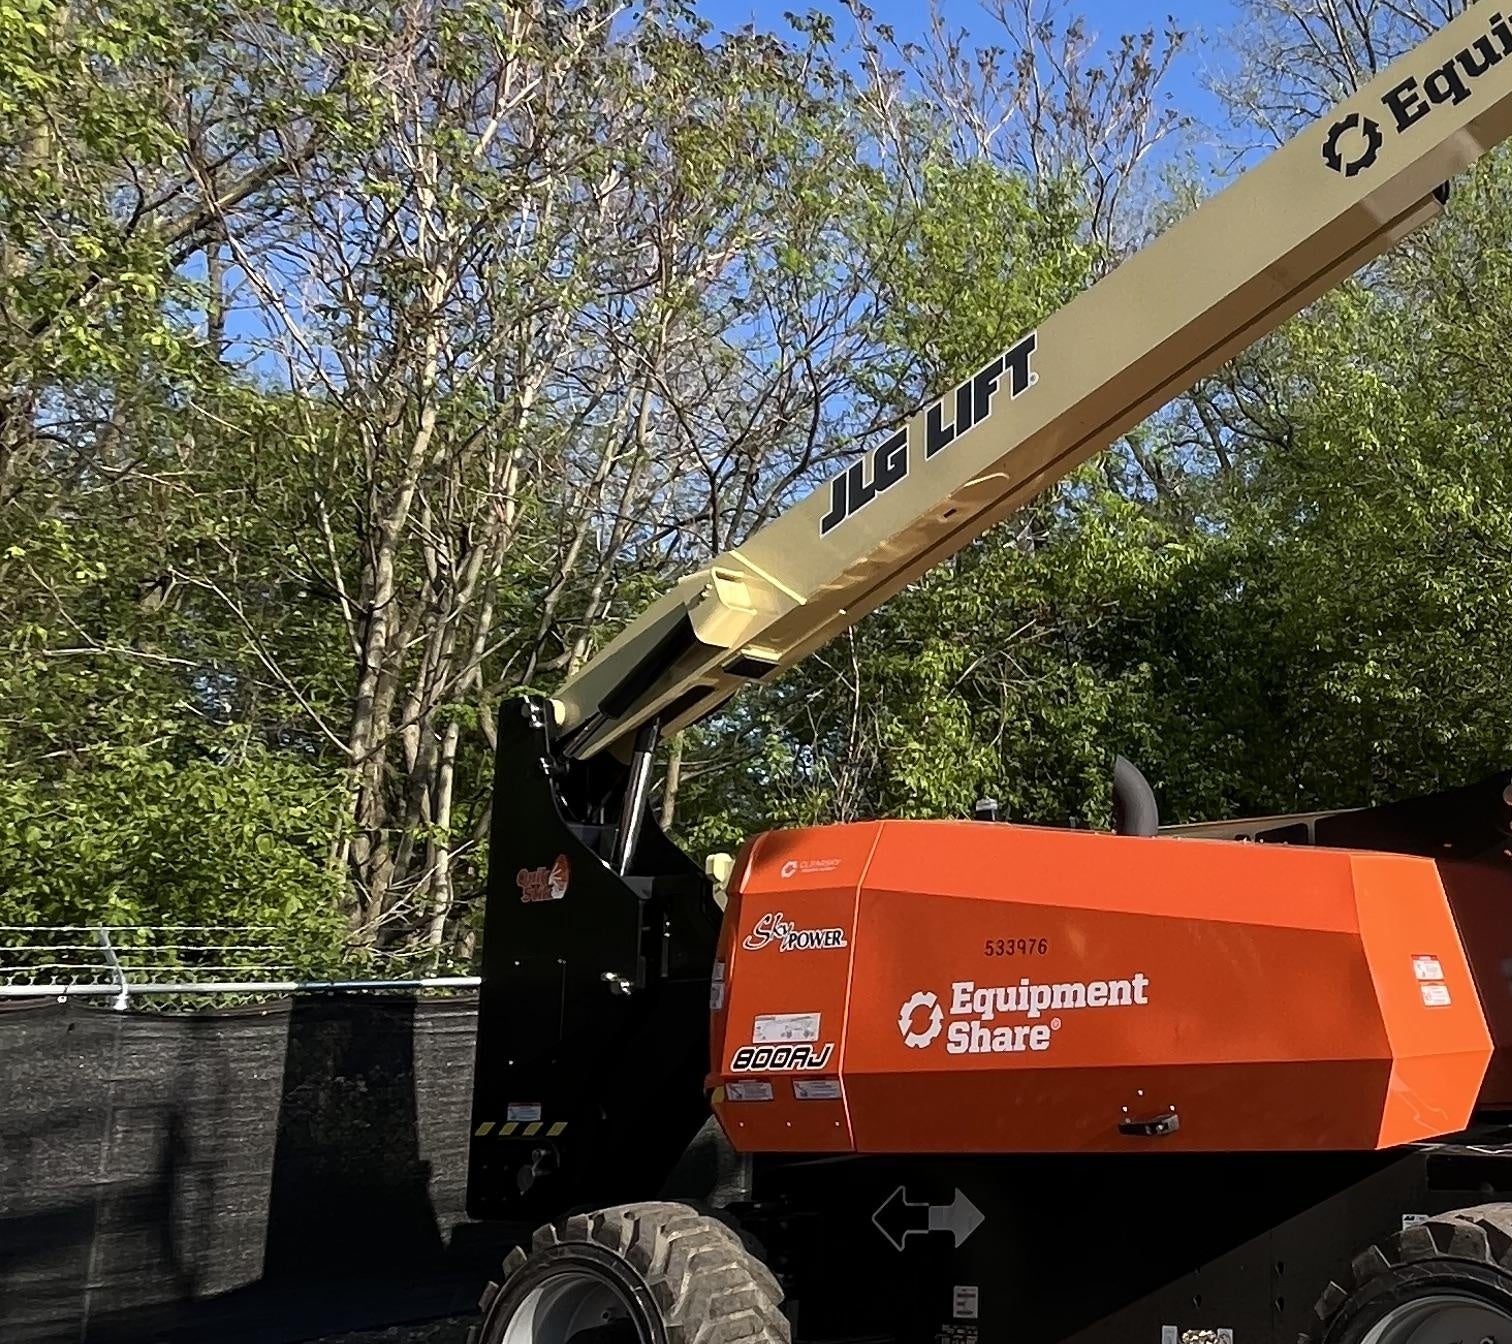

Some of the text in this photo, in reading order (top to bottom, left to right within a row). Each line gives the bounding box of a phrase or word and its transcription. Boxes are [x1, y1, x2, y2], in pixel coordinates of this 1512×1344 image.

[820, 330, 1039, 538] JLG LIFT
[984, 937, 1048, 956] 533976
[950, 972, 1149, 1020] Equipment
[730, 1043, 835, 1072] 800AJ
